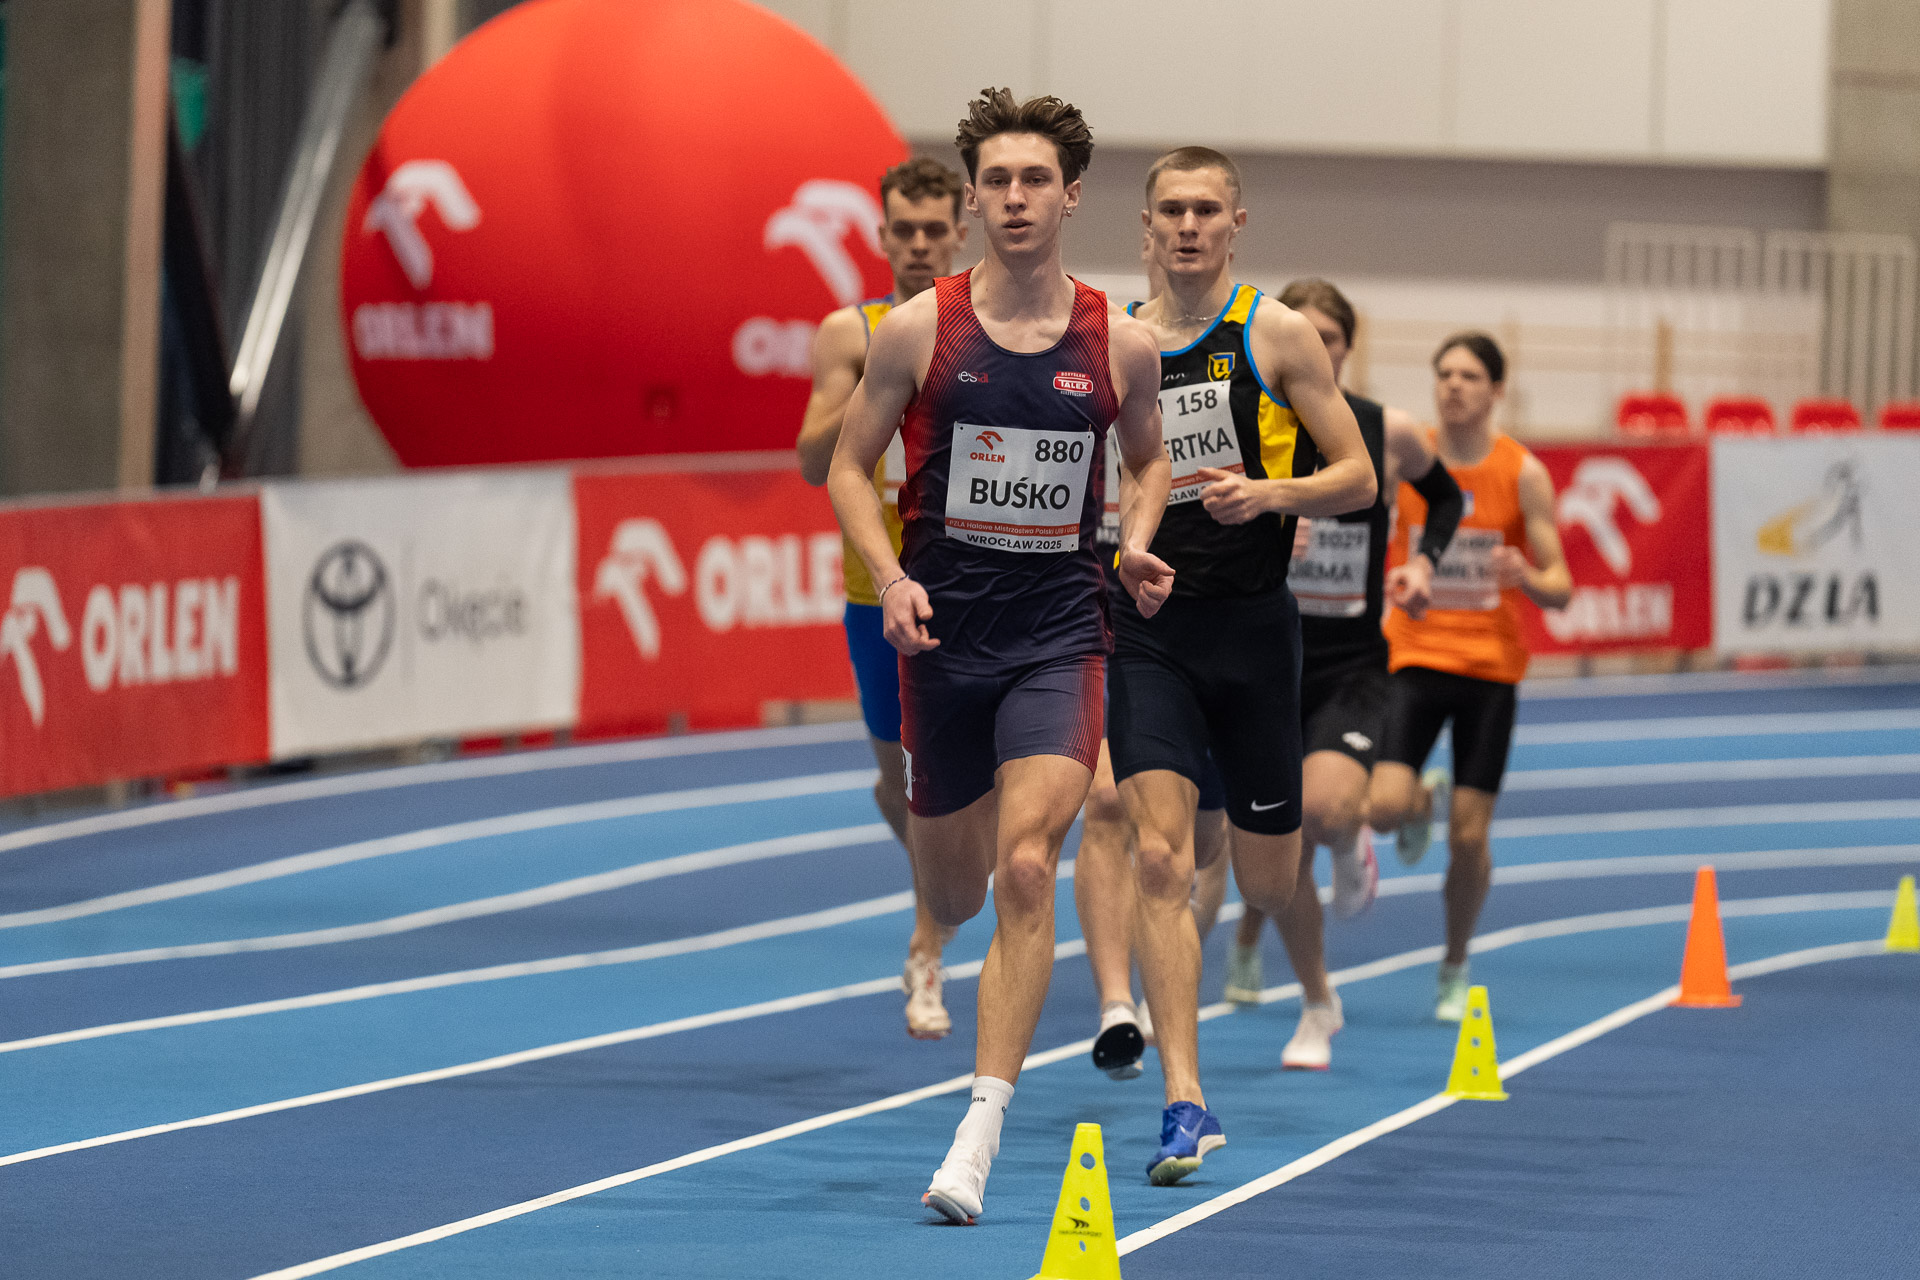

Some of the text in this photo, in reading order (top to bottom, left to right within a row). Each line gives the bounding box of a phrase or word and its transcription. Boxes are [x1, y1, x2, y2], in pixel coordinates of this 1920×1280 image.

[1058, 379, 1089, 390] TALEX
[1176, 388, 1218, 416] 158
[969, 451, 1006, 463] ORLEN
[1035, 438, 1084, 463] 880
[969, 476, 1071, 510] BUŚKO
[966, 522, 993, 531] Halowe
[994, 525, 1034, 535] Mistrzostwa
[966, 533, 1062, 550] WROCŁAW 2025
[82, 577, 240, 692] ORLEN
